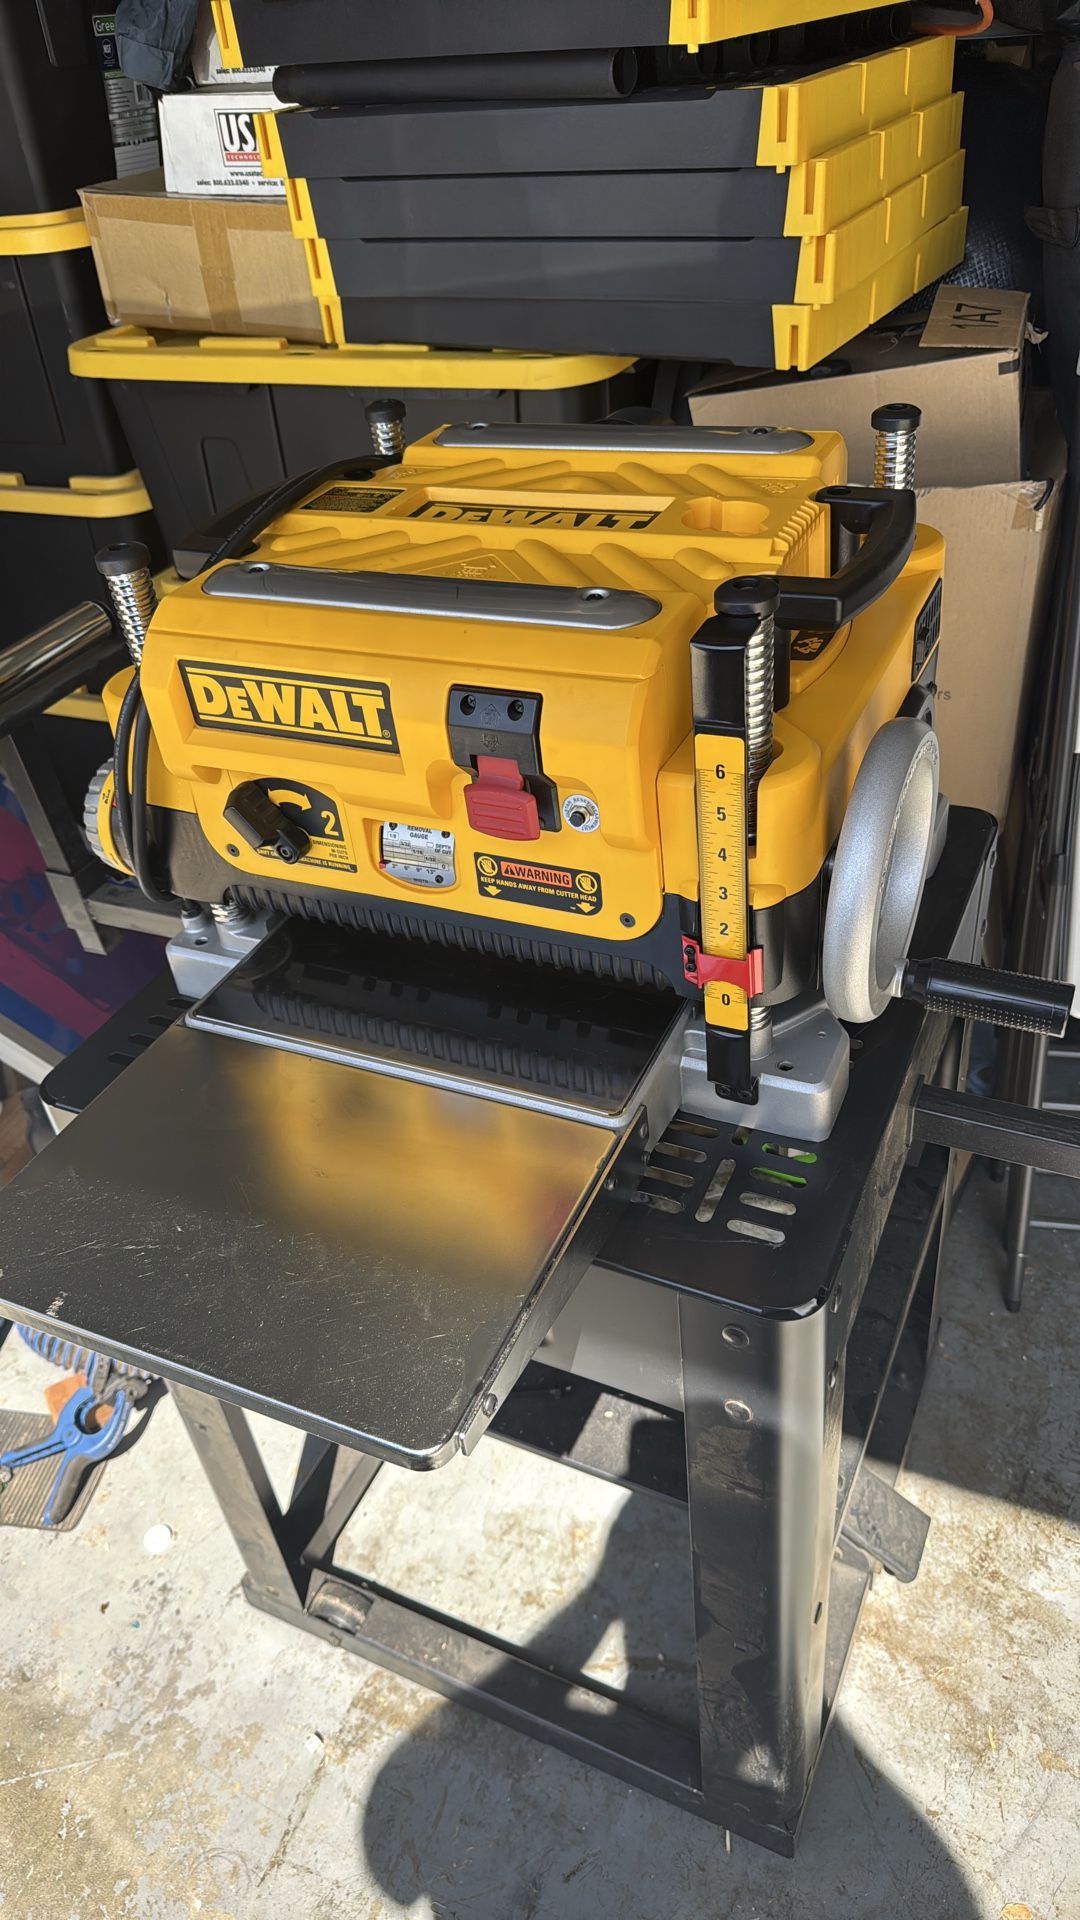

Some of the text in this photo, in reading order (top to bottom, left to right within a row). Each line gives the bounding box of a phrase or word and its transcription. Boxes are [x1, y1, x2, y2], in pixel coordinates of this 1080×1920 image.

[219, 113, 259, 153] US
[426, 504, 655, 530] DEWALT
[937, 690, 951, 701] rs
[187, 673, 385, 738] DEWALT
[715, 764, 726, 779] 6
[716, 807, 727, 821] 5
[321, 810, 339, 836] 2
[407, 825, 432, 834] REMOVAL
[717, 848, 727, 861] 4
[515, 865, 570, 885] WARNING
[480, 876, 597, 902] KEEP HANDS AWAY FROM CUTTER HEAD
[718, 887, 728, 900] 3
[719, 923, 729, 936] 2
[721, 993, 731, 1006] 0
